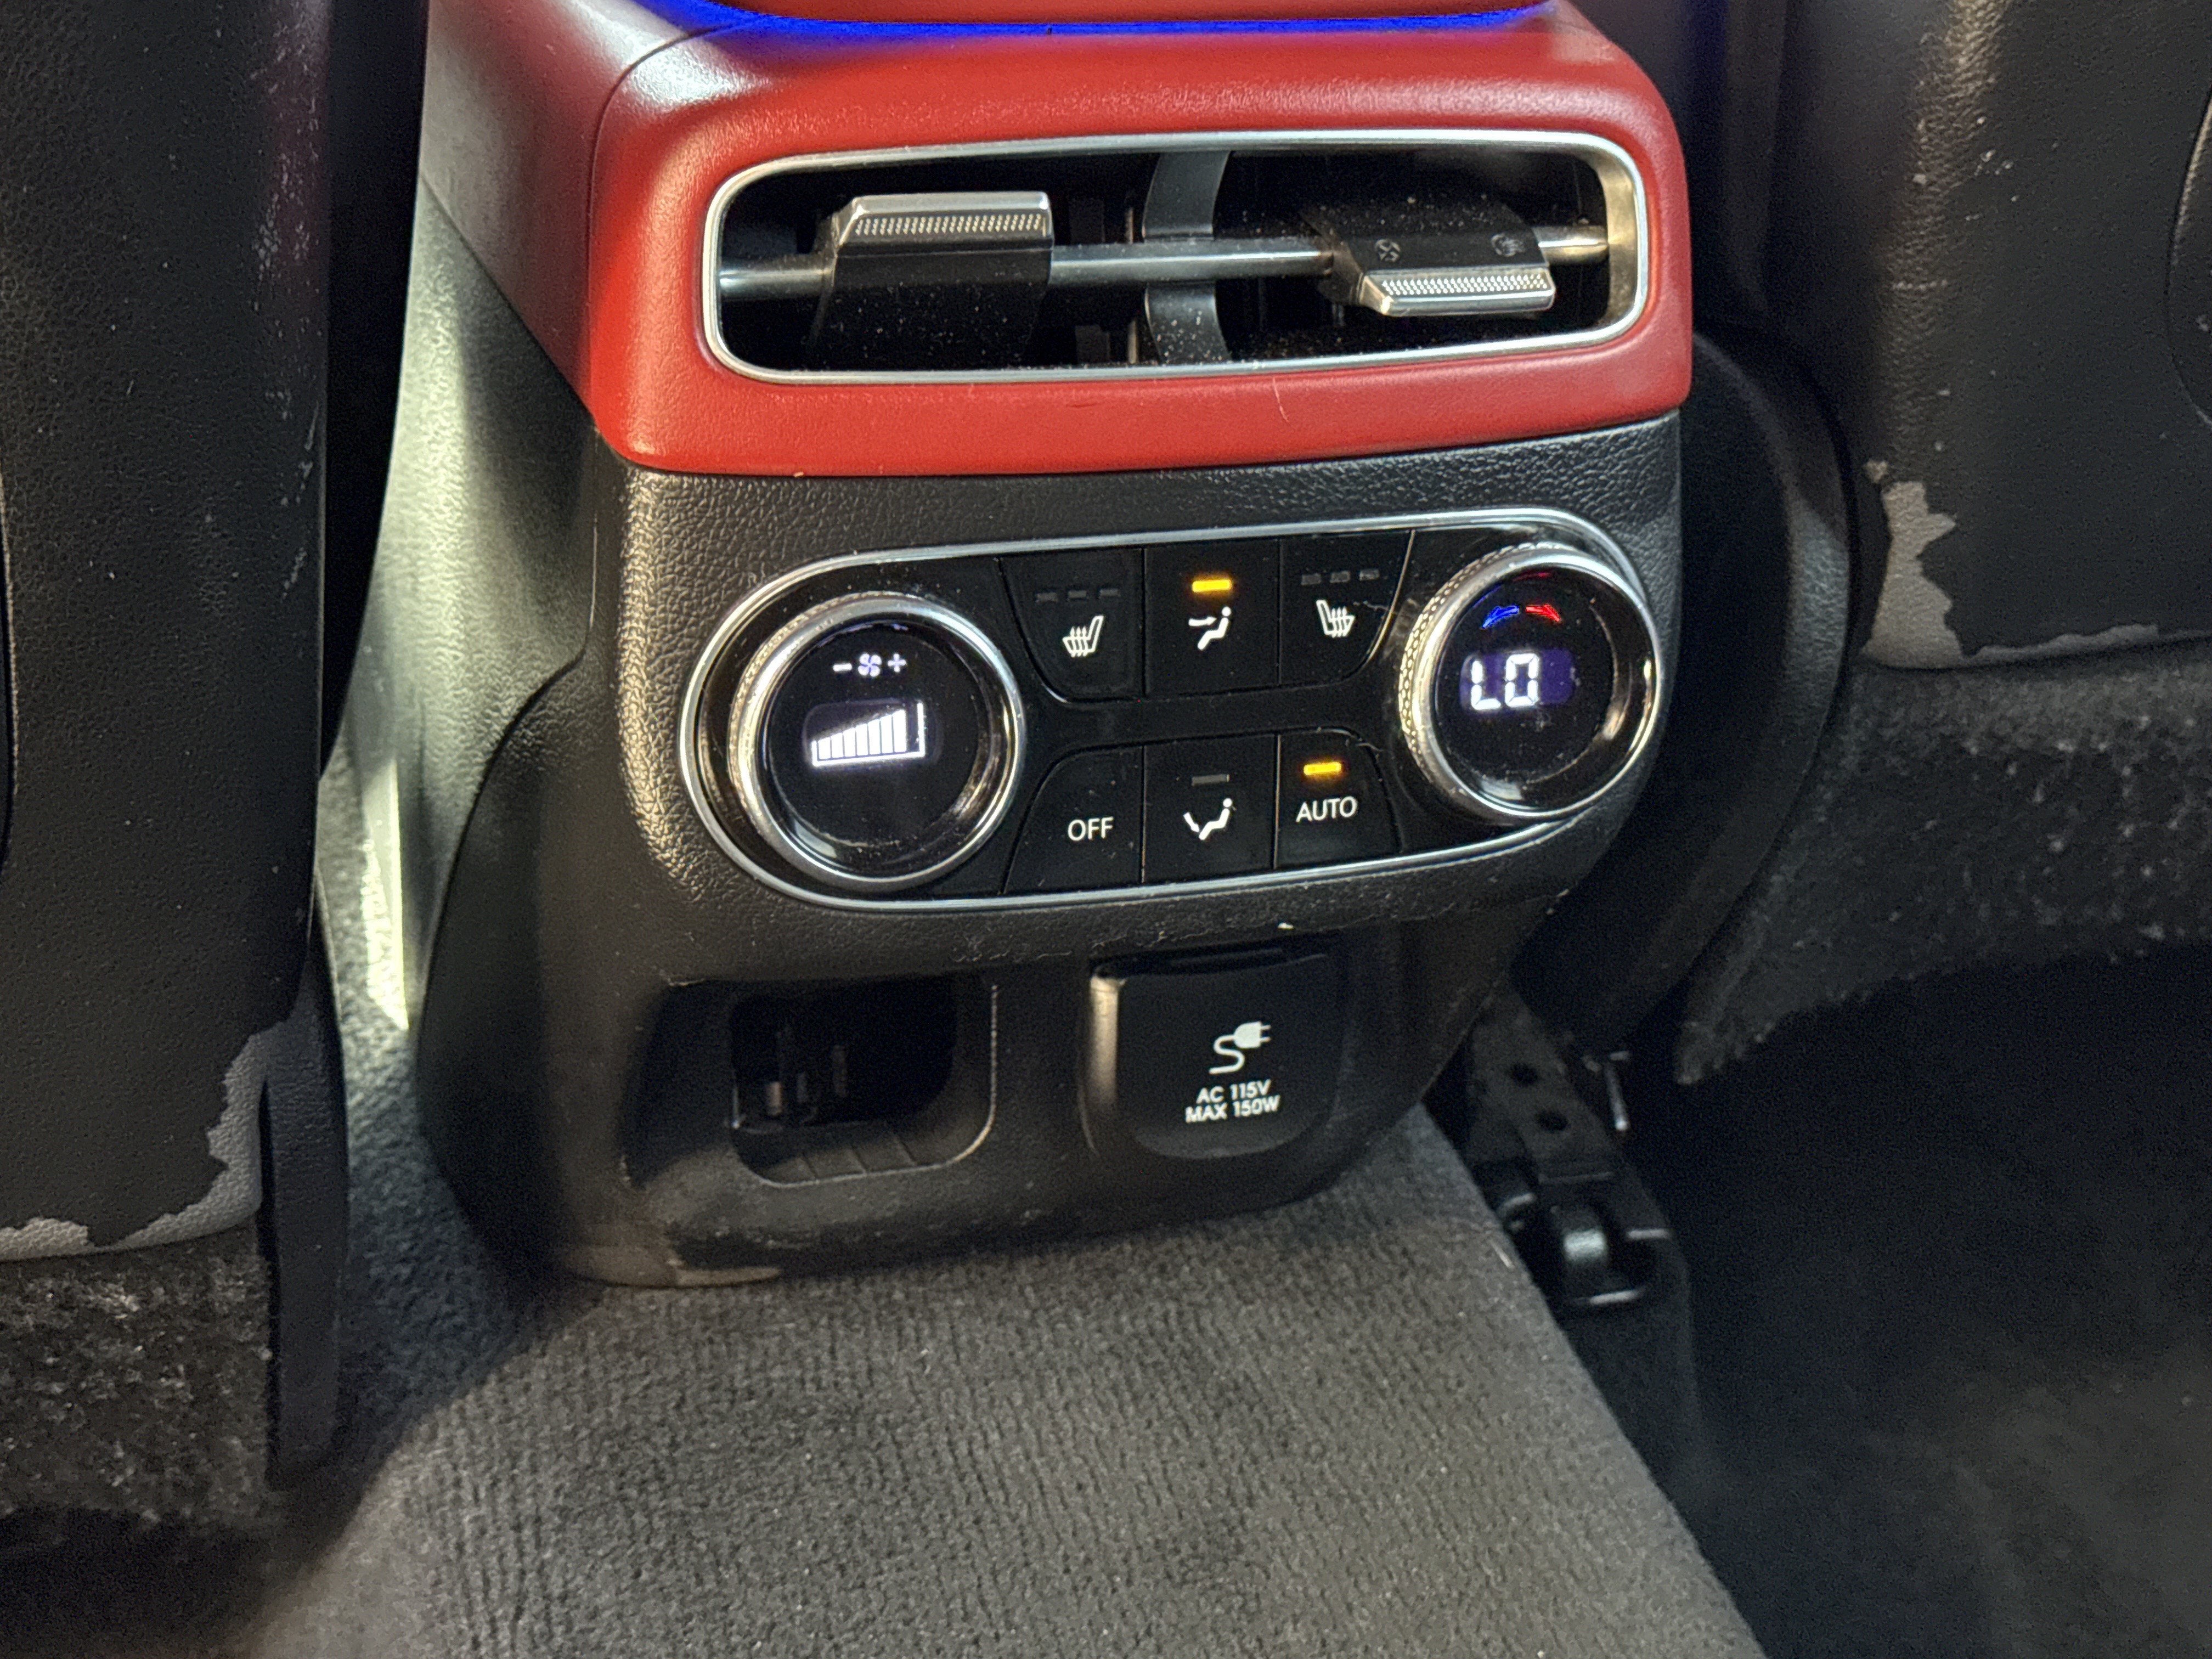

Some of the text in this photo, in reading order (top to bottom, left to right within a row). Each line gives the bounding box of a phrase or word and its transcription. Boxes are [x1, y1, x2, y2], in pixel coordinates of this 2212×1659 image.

[1295, 795, 1358, 823] AUTO
[1067, 816, 1114, 842] OFF
[1196, 1079, 1272, 1104] AC 115V
[1185, 1094, 1281, 1123] MAX 150W
